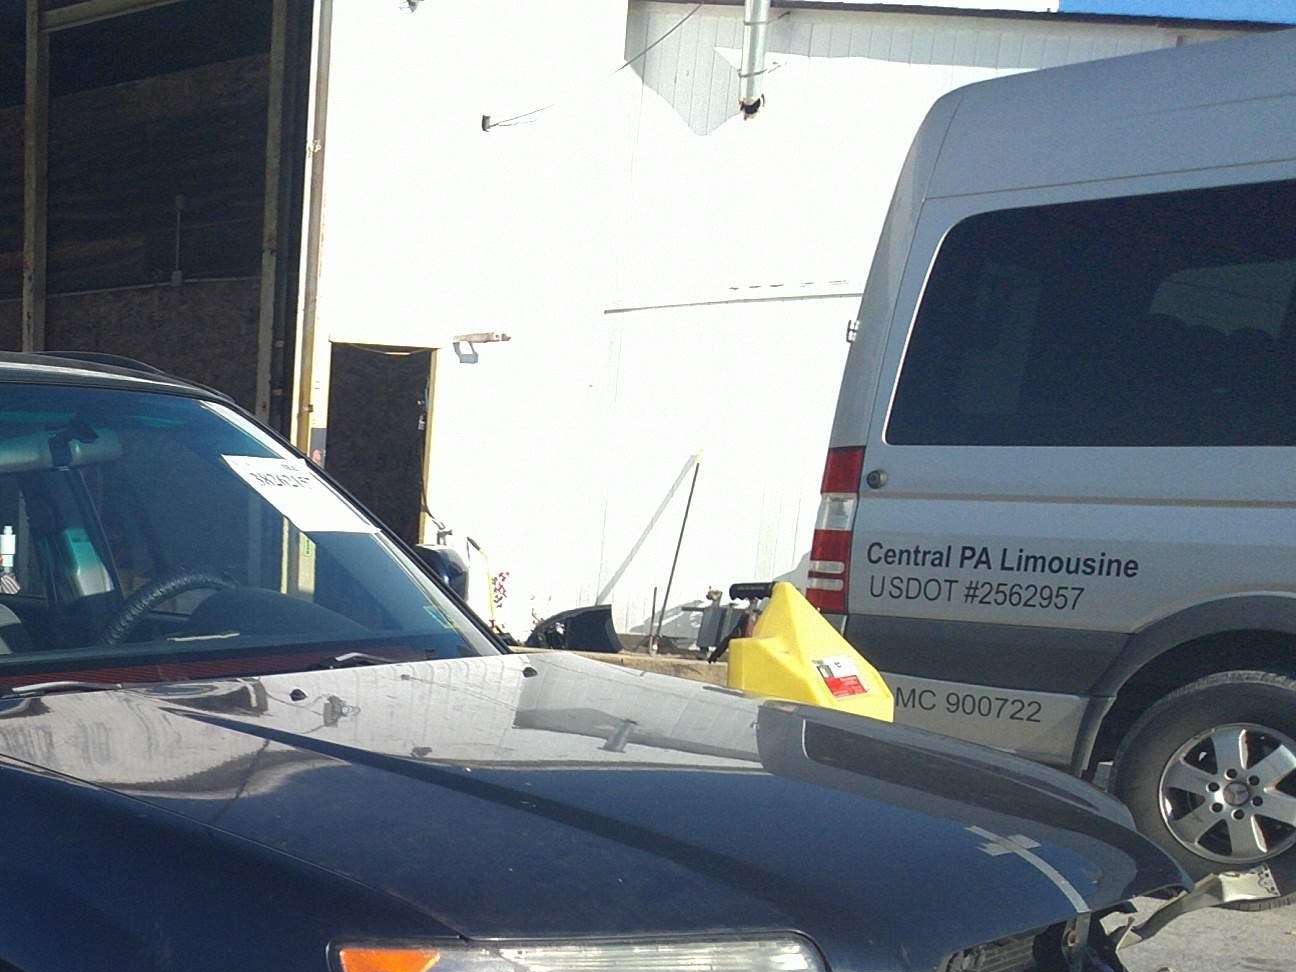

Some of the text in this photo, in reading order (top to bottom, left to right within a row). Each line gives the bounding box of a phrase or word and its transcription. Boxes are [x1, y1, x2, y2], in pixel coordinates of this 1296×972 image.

[867, 542, 1139, 578] Central PA Limousine
[870, 575, 1086, 611] USDOT #2562957
[895, 687, 1042, 723] MC 900722
